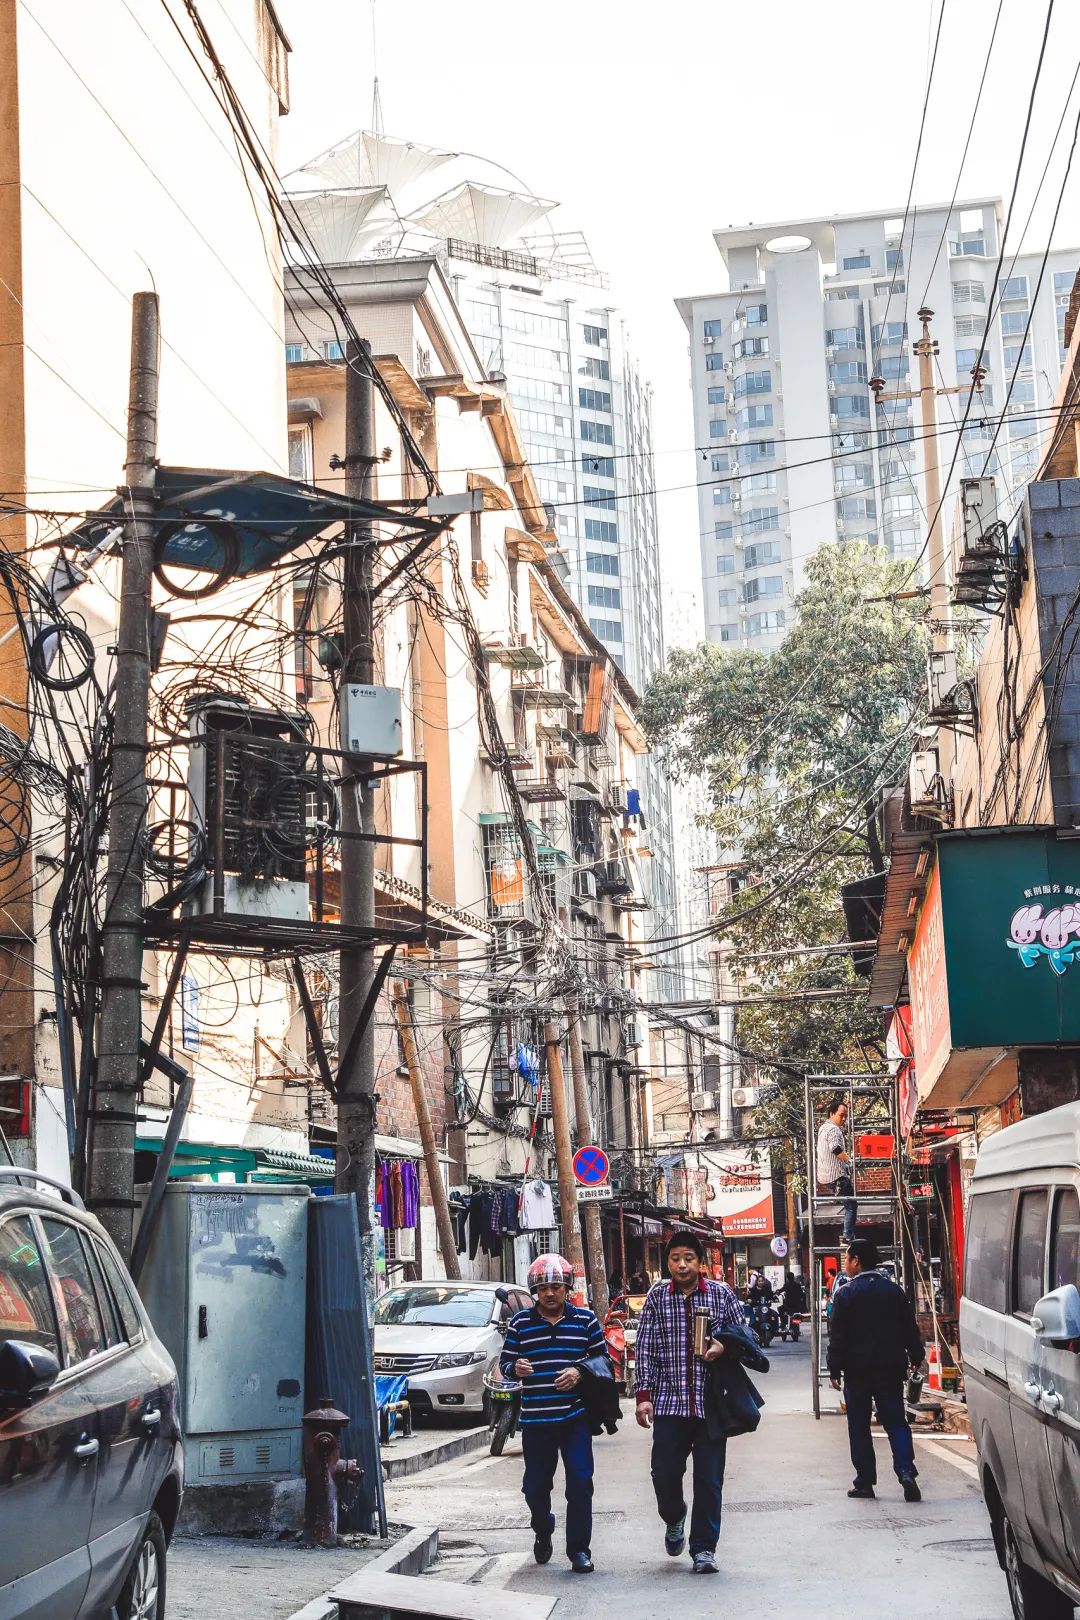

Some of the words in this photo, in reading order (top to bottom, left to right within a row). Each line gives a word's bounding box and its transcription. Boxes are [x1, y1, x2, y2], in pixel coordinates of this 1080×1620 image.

[579, 1189, 610, 1198] 全路段禁停
